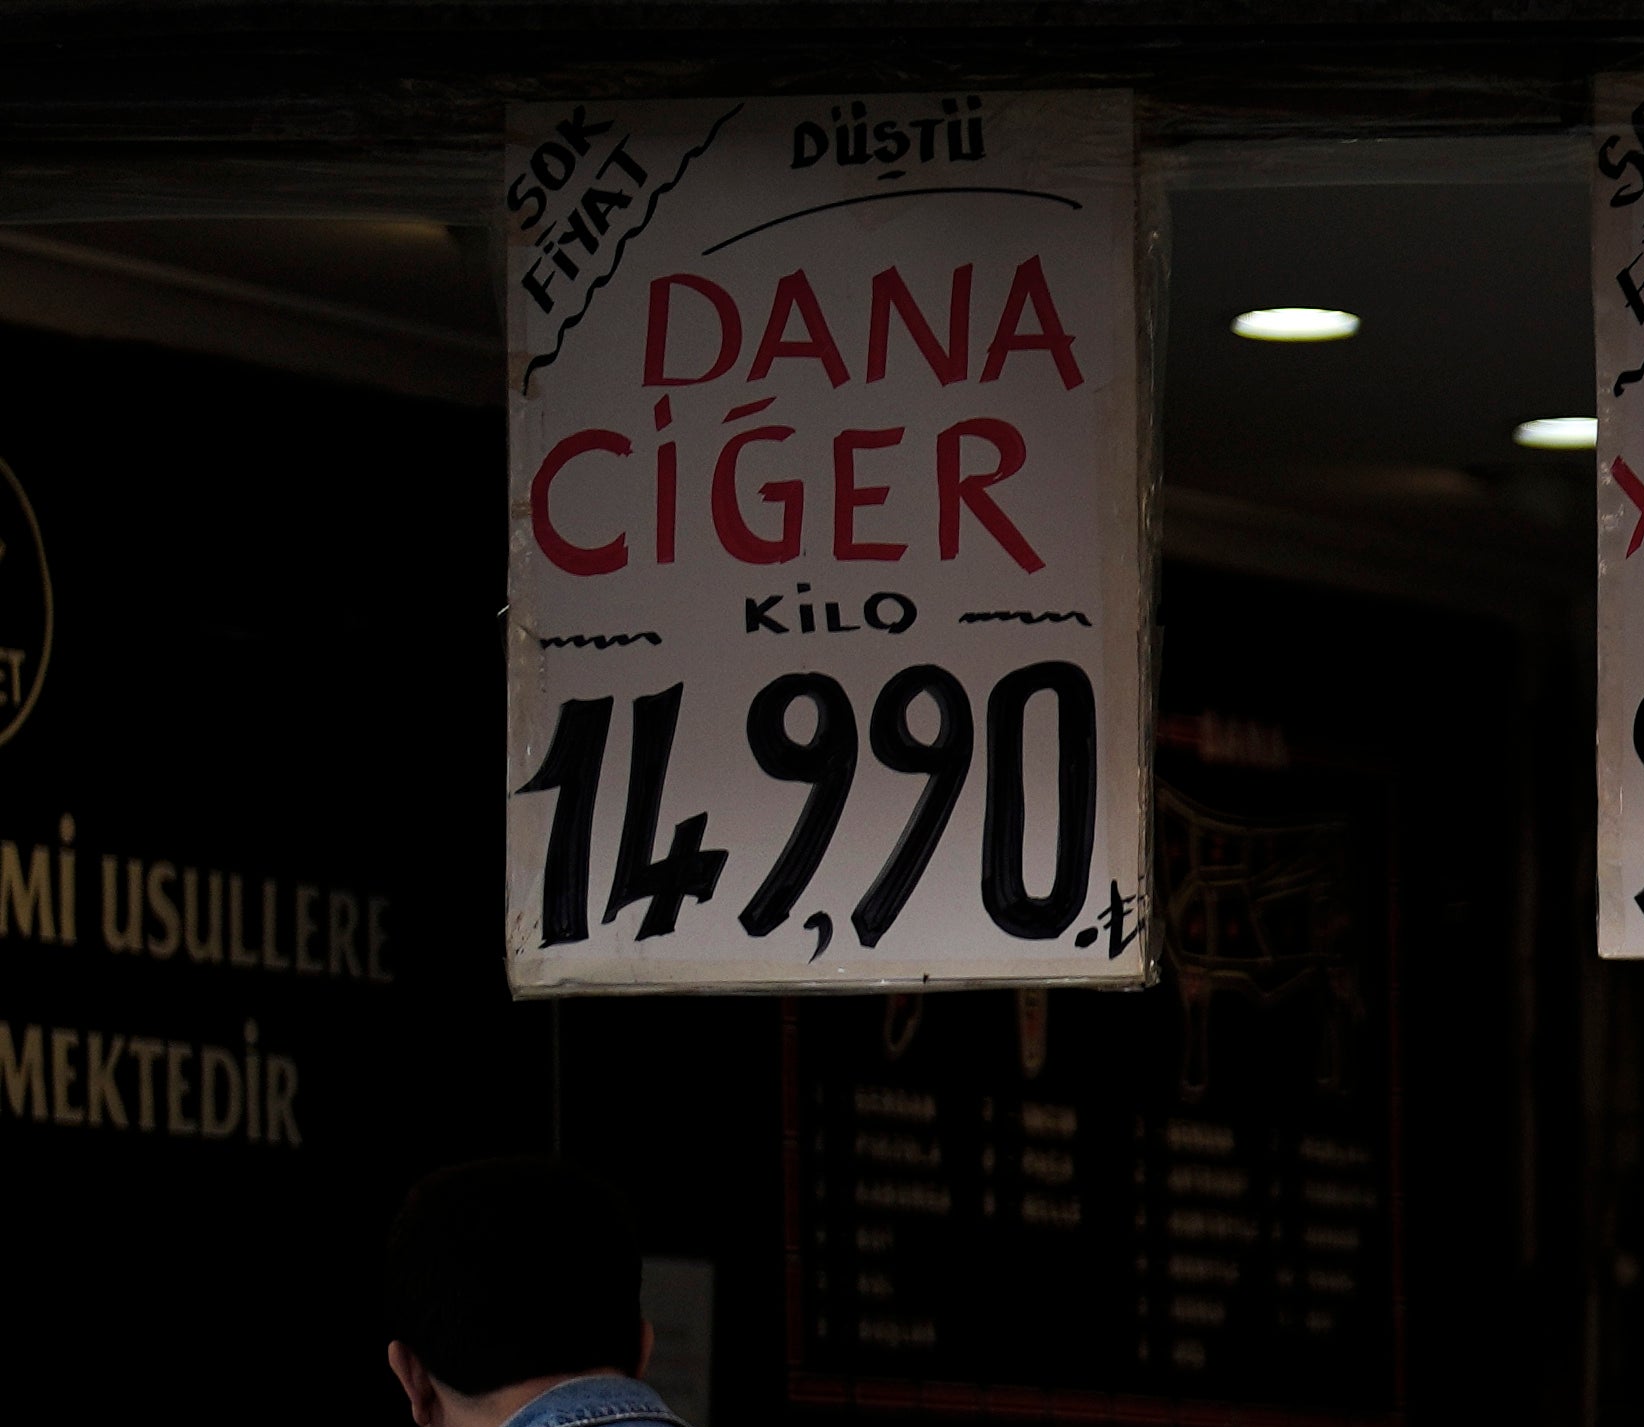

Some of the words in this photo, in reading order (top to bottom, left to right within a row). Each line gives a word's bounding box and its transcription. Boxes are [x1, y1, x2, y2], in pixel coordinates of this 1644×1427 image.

[790, 95, 986, 180] DÜŞTÜ
[522, 144, 650, 314] FİYAT
[641, 255, 1085, 391] DANA
[531, 394, 1046, 577] CİĞER
[745, 583, 918, 635] KİLO
[102, 853, 394, 984] USULLERE
